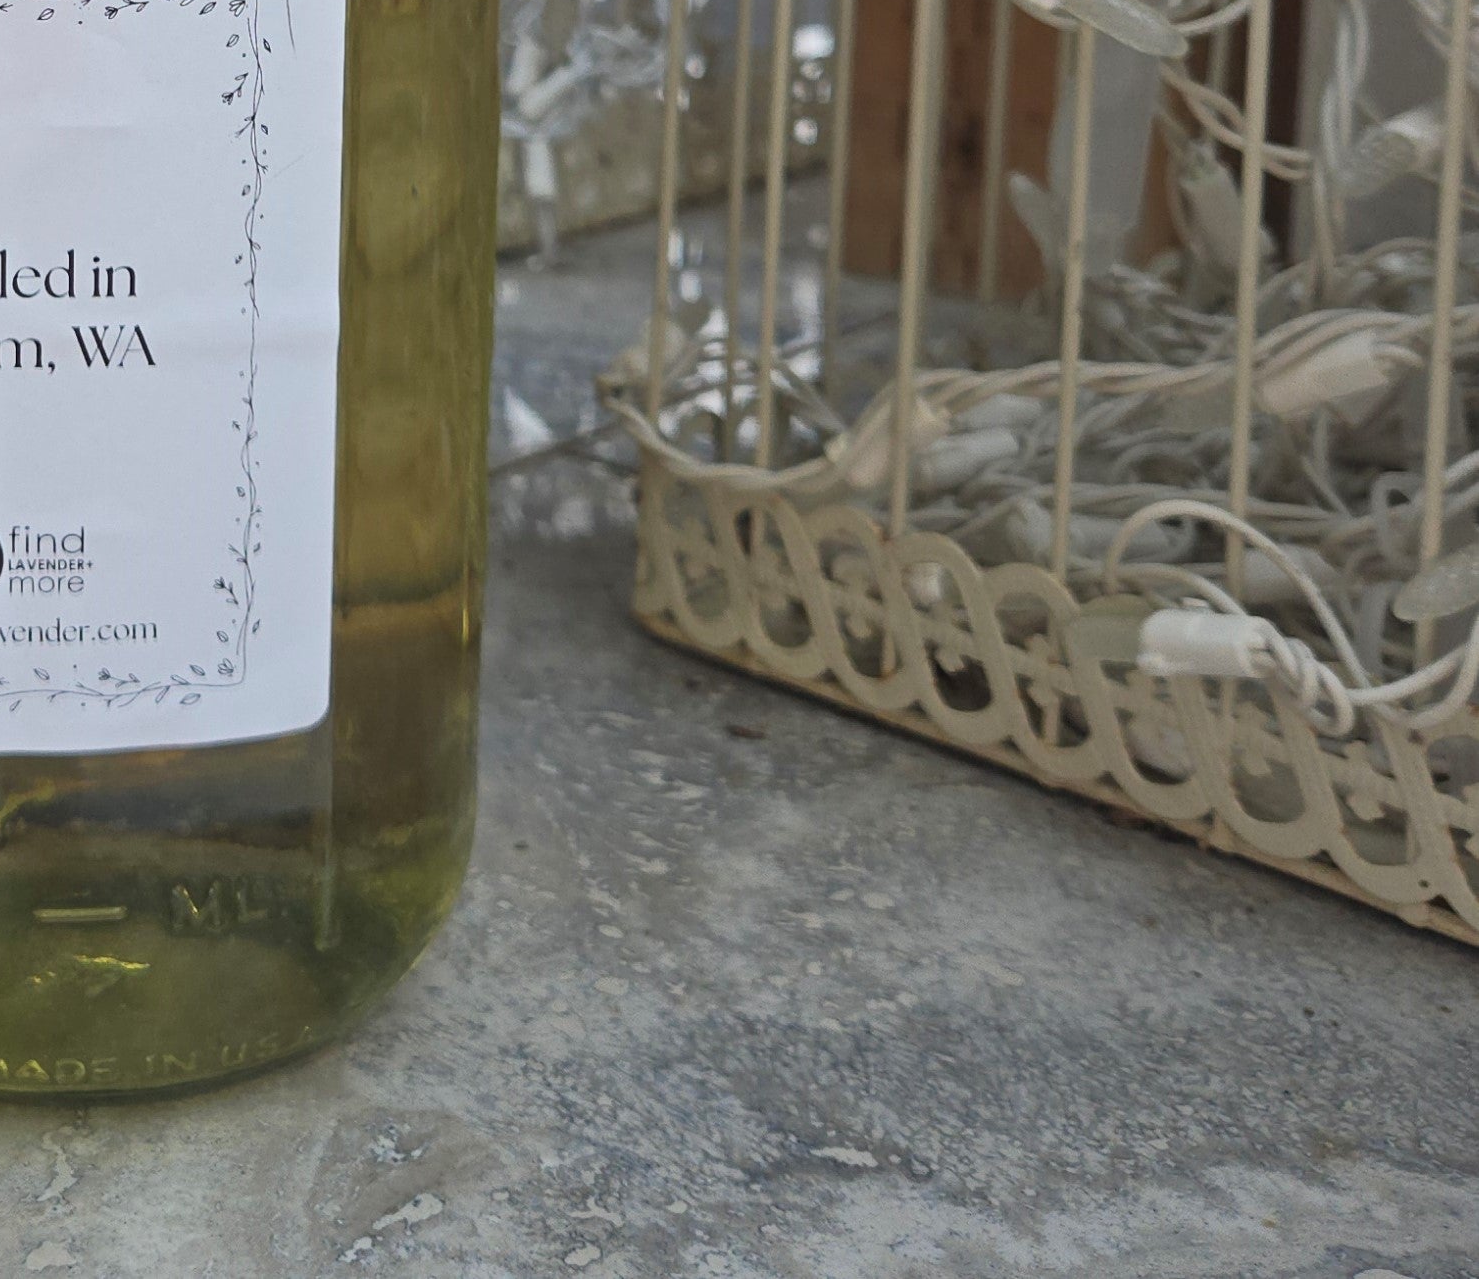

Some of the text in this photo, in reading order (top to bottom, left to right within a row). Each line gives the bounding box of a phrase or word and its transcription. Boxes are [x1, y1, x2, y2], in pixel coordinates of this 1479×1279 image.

[91, 255, 137, 298] in
[71, 324, 157, 368] WA
[8, 525, 86, 555] find
[8, 574, 86, 595] more
[143, 1050, 199, 1078] IN
